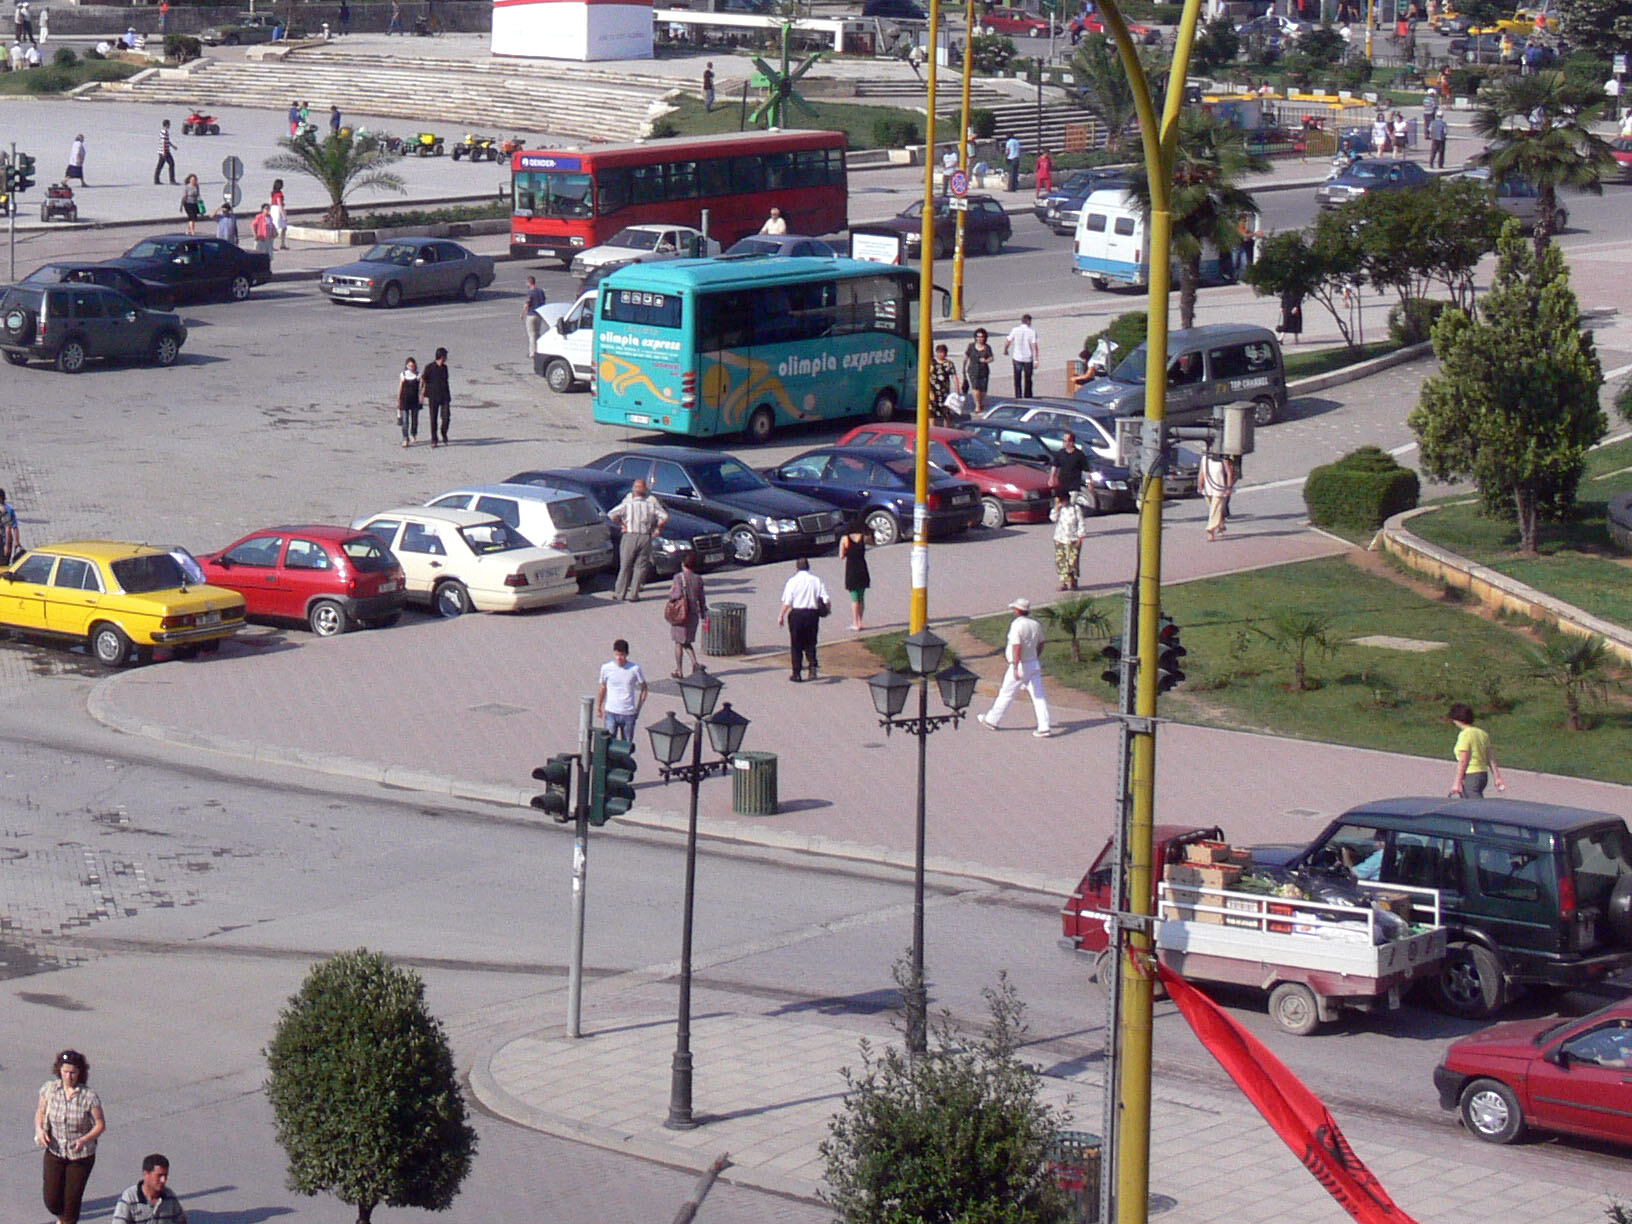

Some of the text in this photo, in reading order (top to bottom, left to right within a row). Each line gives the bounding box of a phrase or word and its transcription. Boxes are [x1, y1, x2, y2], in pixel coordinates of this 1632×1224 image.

[599, 331, 640, 347] olimpia
[641, 338, 681, 351] express
[778, 348, 896, 377] olimpia express
